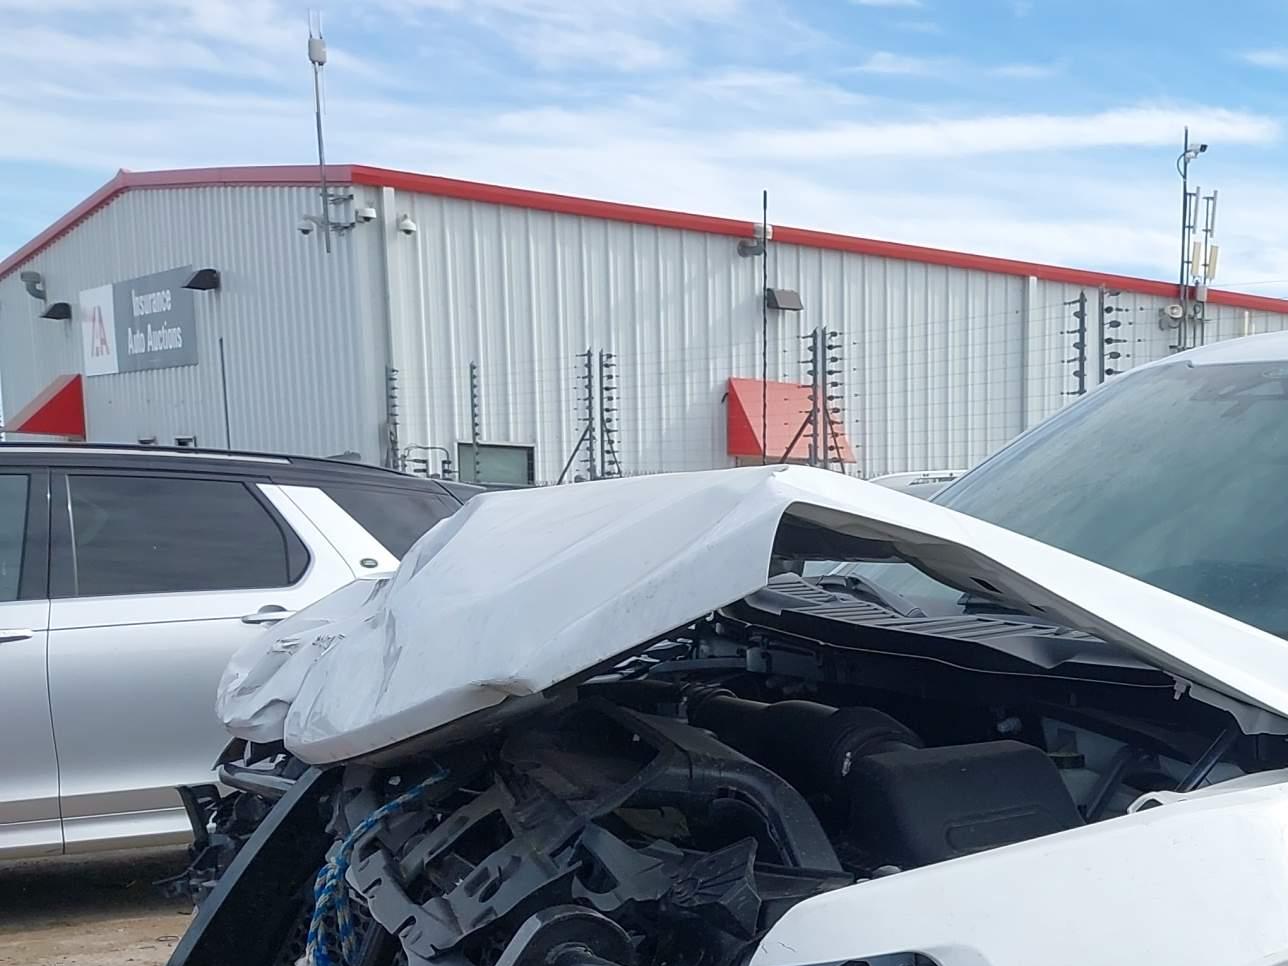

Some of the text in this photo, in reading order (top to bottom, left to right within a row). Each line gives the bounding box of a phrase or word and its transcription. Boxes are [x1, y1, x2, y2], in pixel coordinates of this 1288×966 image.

[131, 288, 172, 317] Insurance
[127, 320, 183, 355] Auto Auctions
